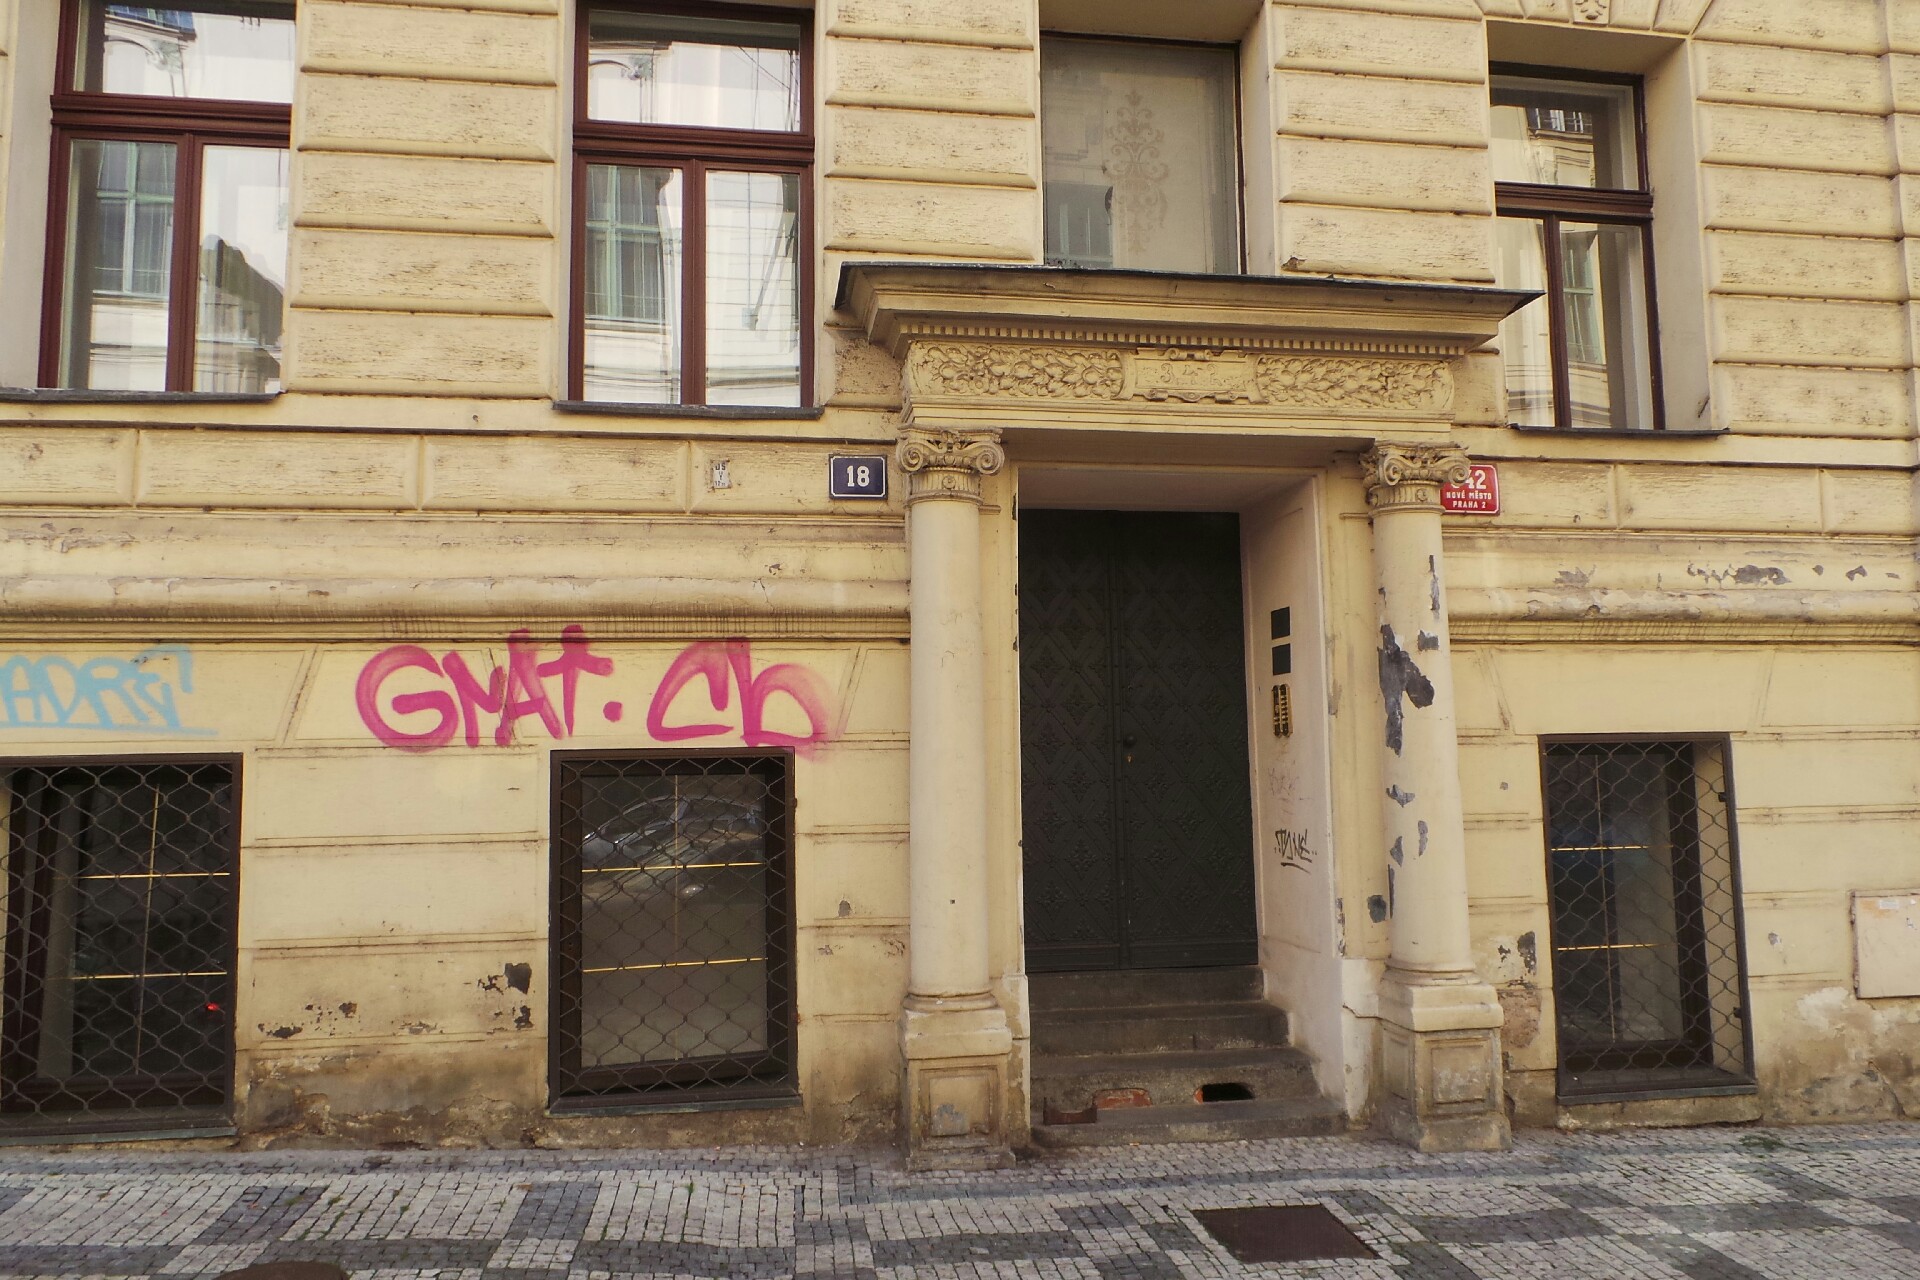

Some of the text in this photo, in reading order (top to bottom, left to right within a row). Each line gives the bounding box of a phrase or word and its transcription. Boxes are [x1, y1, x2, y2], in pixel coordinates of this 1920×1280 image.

[847, 465, 870, 487] 18
[1451, 469, 1487, 490] 42
[1446, 490, 1492, 500] NOVÉ MĚSTO
[1452, 501, 1487, 509] PRAHA 2
